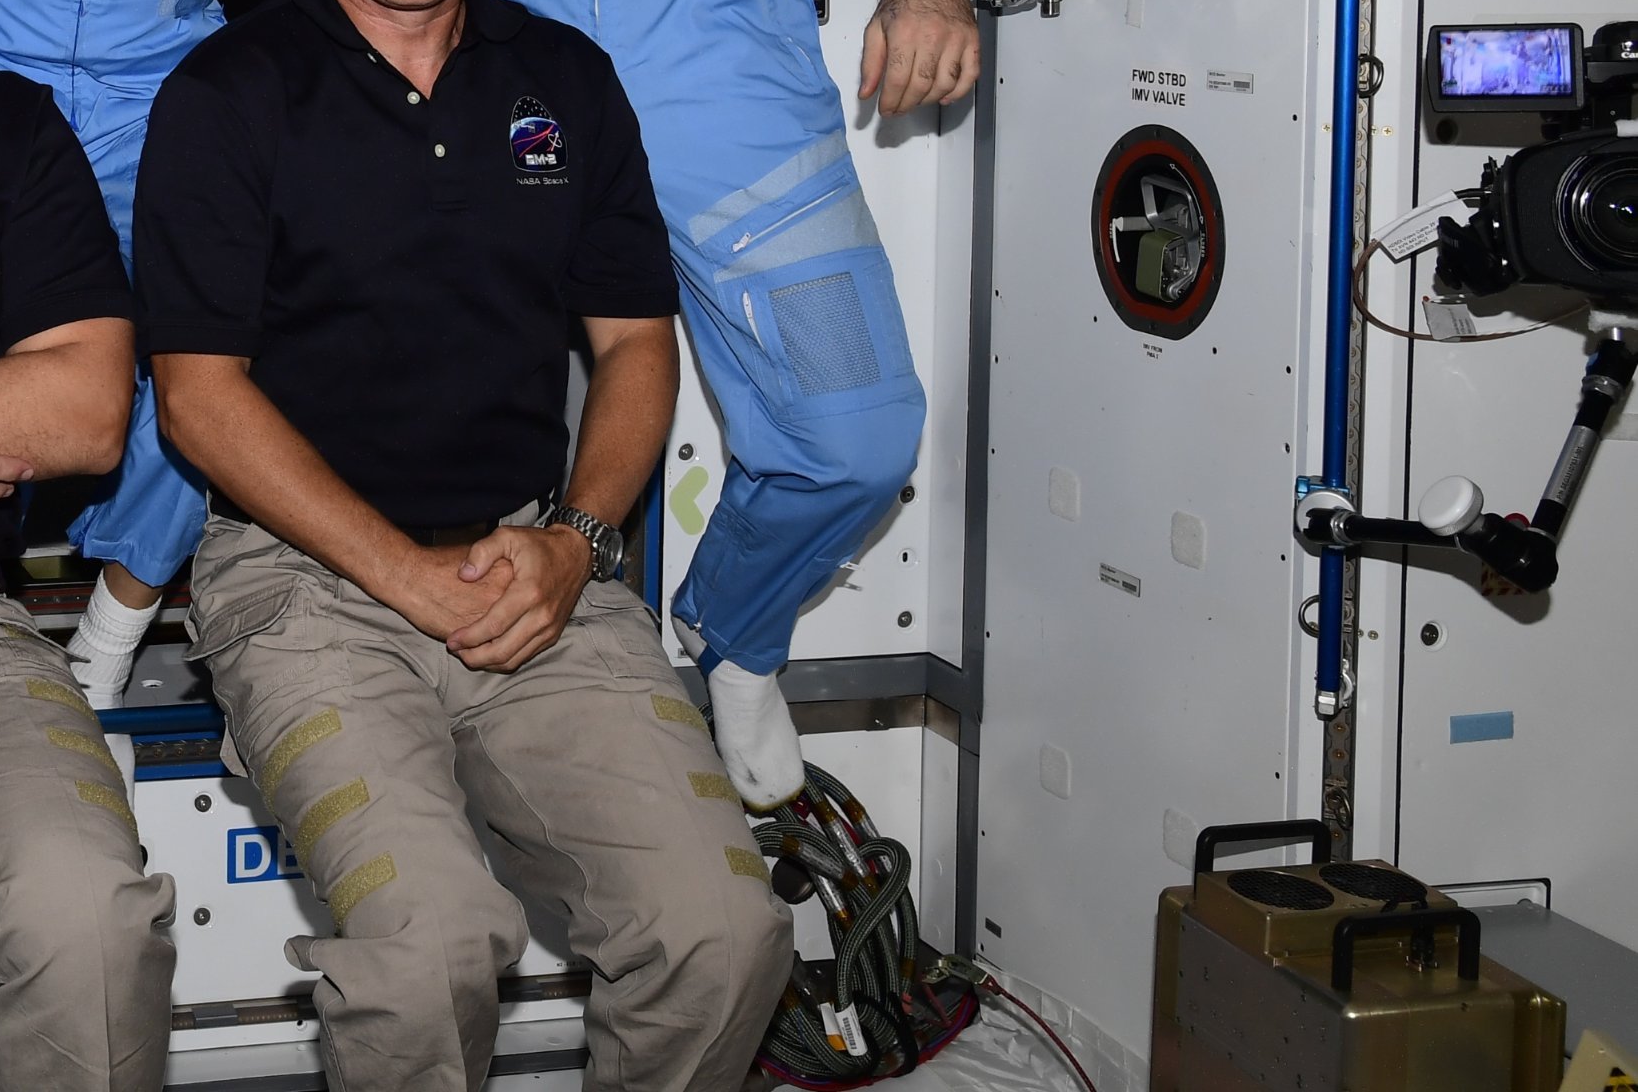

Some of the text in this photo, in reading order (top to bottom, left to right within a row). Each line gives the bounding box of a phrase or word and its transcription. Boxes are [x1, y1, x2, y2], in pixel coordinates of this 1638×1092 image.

[1132, 69, 1187, 87] FWD STBD
[1131, 88, 1186, 107] IMV VALVE
